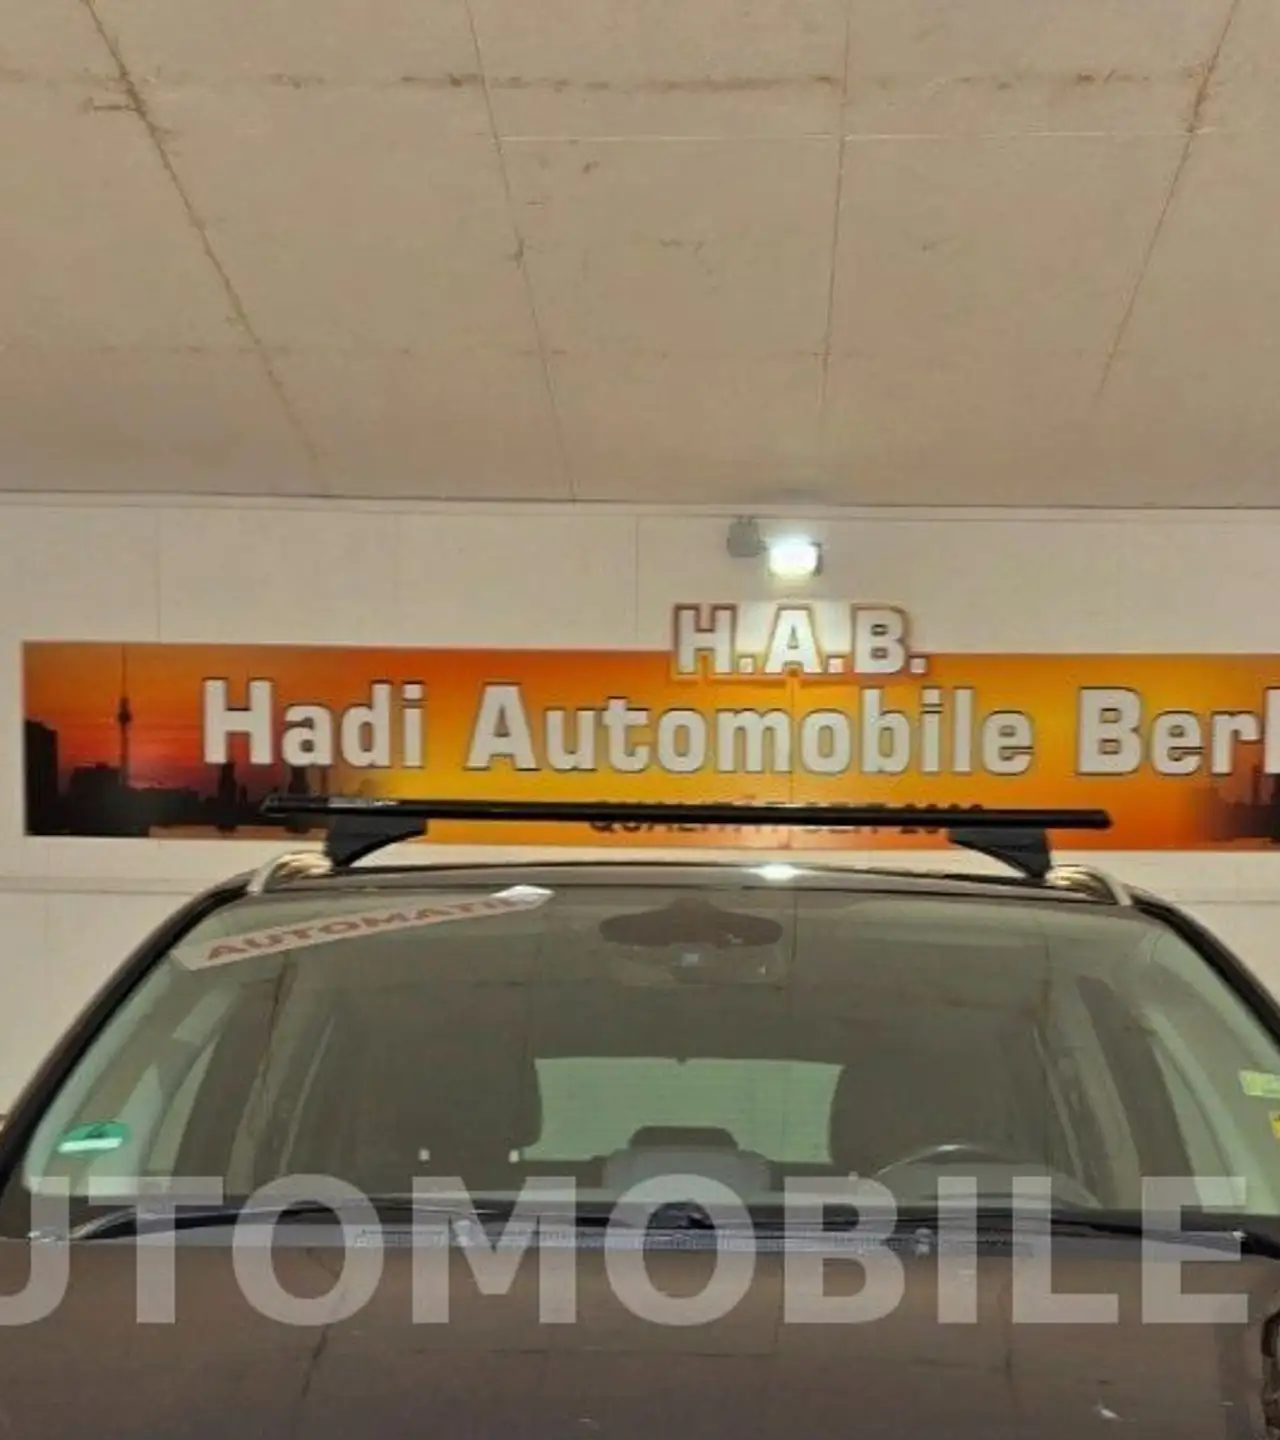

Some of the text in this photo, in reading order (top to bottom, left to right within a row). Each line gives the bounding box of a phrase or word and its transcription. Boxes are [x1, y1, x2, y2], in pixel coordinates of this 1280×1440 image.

[673, 603, 929, 676] H.A.B.
[202, 677, 426, 768] Hadi
[463, 682, 1035, 776] Automobile
[207, 894, 536, 961] AUTOMATI
